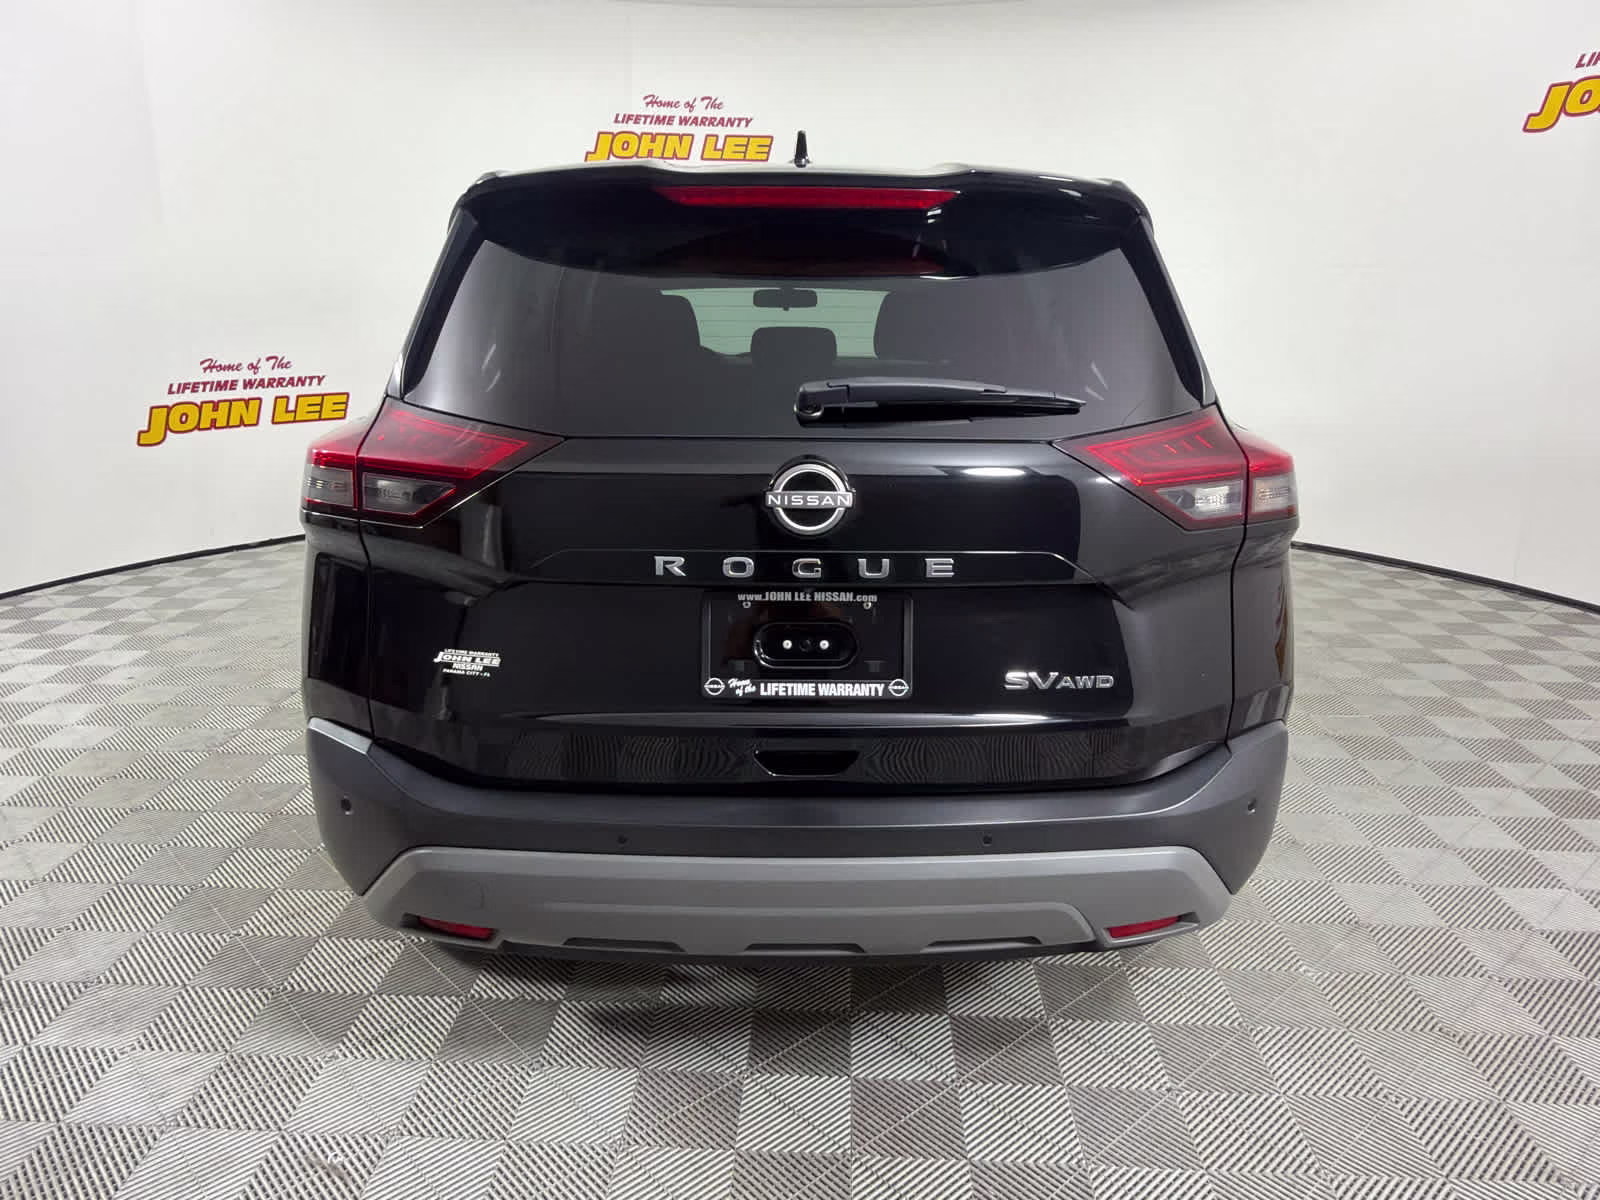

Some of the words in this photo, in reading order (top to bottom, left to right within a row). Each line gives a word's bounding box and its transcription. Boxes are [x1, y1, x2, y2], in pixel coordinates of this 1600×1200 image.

[643, 94, 680, 110] Home
[684, 97, 697, 113] of
[701, 96, 724, 110] The
[1522, 75, 1600, 133] JO
[613, 113, 676, 126] LIFETIME
[678, 115, 753, 128] WARRANTY
[584, 131, 694, 162] JOHN
[701, 134, 774, 162] LEE
[200, 358, 243, 373] Home
[247, 358, 261, 375] of
[265, 356, 293, 370] The
[167, 379, 239, 395] LIFETIME
[242, 375, 326, 390] WARRANTY
[137, 397, 262, 447] JOHN
[271, 392, 350, 424] LEE
[768, 494, 850, 506] NISSAN
[653, 555, 956, 579] ROGUE
[794, 591, 812, 601] LEE
[433, 651, 473, 663] JOHN
[474, 656, 501, 667] LEE
[452, 663, 483, 671] NISSAN
[759, 682, 814, 696] LIFETIME
[818, 682, 886, 697] WARRANTY
[1004, 671, 1060, 690] SV
[1056, 674, 1115, 689] AWD
